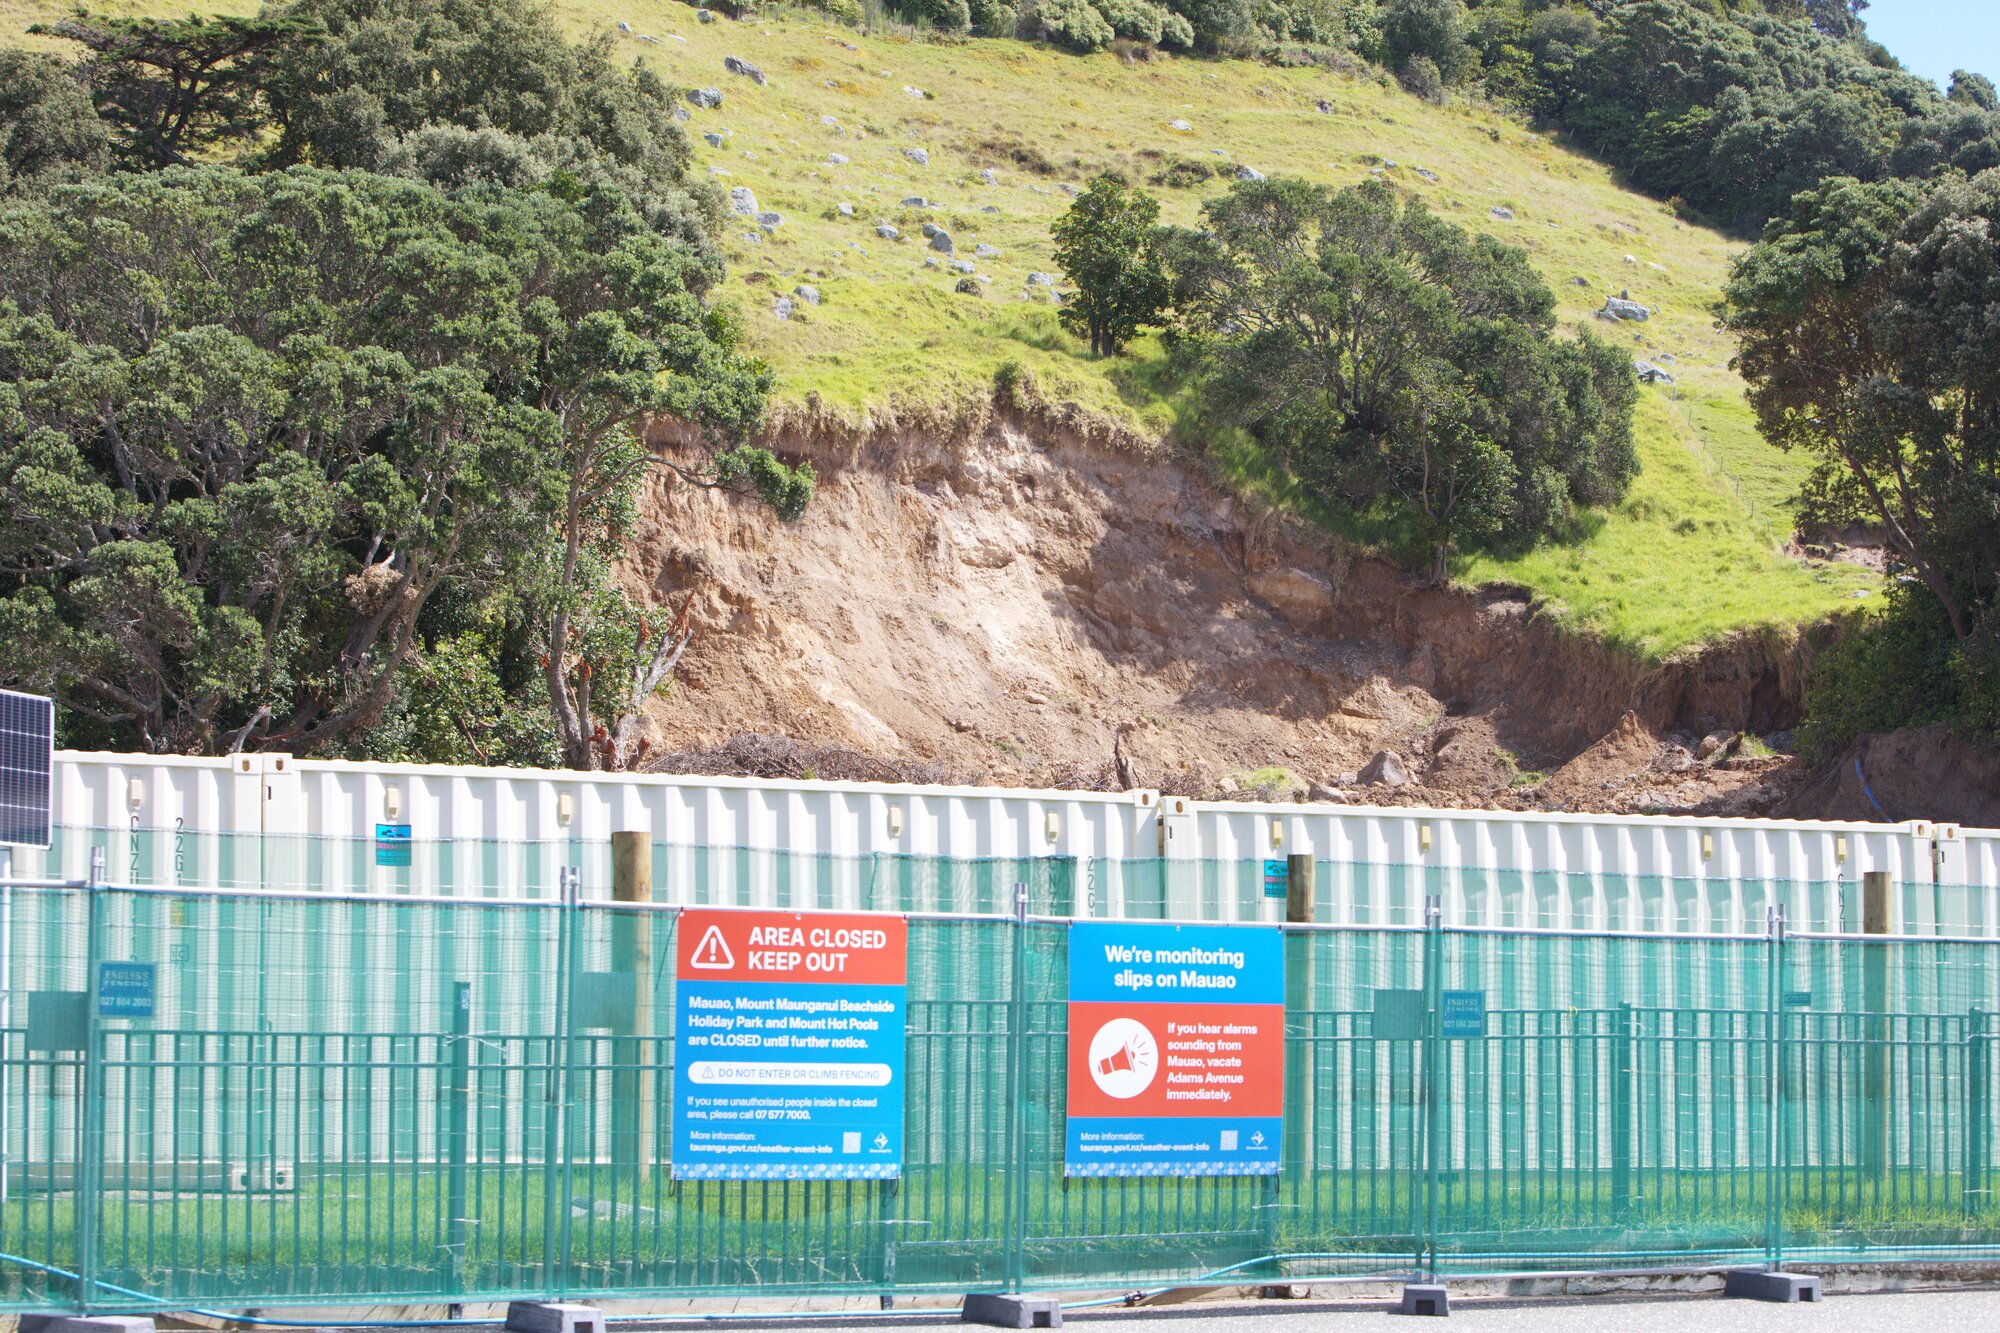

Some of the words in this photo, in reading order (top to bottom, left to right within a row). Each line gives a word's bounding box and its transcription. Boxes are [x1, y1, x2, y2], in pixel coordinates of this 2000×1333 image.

[749, 927, 805, 947] AREA
[810, 928, 886, 949] CLOSED
[749, 951, 801, 971] KEEP
[806, 953, 848, 972] OUT
[1105, 945, 1152, 963] We're
[1156, 947, 1244, 969] monitoring
[105, 970, 149, 980] ENDLESS
[1114, 970, 1153, 991] slips
[1156, 974, 1177, 987] on
[1181, 971, 1236, 988] Mauao
[100, 996, 114, 1006] 027
[689, 996, 733, 1011] Mauao,
[736, 997, 774, 1010] Mount
[776, 998, 838, 1013] Maunganui
[840, 999, 894, 1012] Beachside
[688, 1015, 733, 1030] Holiday
[737, 1016, 763, 1028] Park
[765, 1017, 787, 1029] and
[790, 1017, 826, 1030] Mount
[828, 1018, 847, 1030] Hot
[849, 1018, 879, 1030] Pools
[1168, 1022, 1176, 1034] If
[1177, 1025, 1196, 1036] you
[1198, 1023, 1221, 1034] hear
[1223, 1024, 1257, 1035] alarms
[688, 1036, 708, 1046] are
[710, 1034, 761, 1047] CLOSED
[763, 1035, 789, 1047] until
[791, 1035, 829, 1048] further
[831, 1036, 868, 1048] notice.
[1168, 1039, 1215, 1052] sounding
[1217, 1040, 1241, 1051] from
[1167, 1056, 1205, 1068] Mauao,
[1207, 1058, 1241, 1067] vacate
[719, 1069, 733, 1078] DO
[736, 1069, 757, 1078] NOT
[759, 1069, 791, 1078] ENTER
[793, 1070, 806, 1078] OR
[809, 1070, 838, 1079] CLIMB
[840, 1070, 880, 1079] FENCING
[1167, 1072, 1203, 1084] Adams
[1205, 1073, 1243, 1084] Avenue
[1167, 1089, 1231, 1102] immediately.
[687, 1096, 693, 1106] If
[695, 1098, 711, 1108] you
[713, 1098, 729, 1107] see
[730, 1097, 783, 1107] unauthorised
[785, 1098, 811, 1109] people
[813, 1098, 836, 1107] inside
[838, 1098, 851, 1107] the
[852, 1098, 877, 1108] closed
[687, 1111, 708, 1120] area,
[710, 1110, 737, 1121] please
[739, 1110, 754, 1119] call
[755, 1110, 767, 1119] 07
[768, 1110, 785, 1120] 577
[786, 1110, 810, 1120] 7000.
[690, 1131, 710, 1140] More
[712, 1131, 756, 1141] information:
[1081, 1133, 1099, 1141] More
[1101, 1133, 1144, 1142] information:
[690, 1144, 832, 1154] tauranga.govt.nz/weather-event-info
[1080, 1144, 1209, 1153] tauranga.govt.nz/weather-event-info
